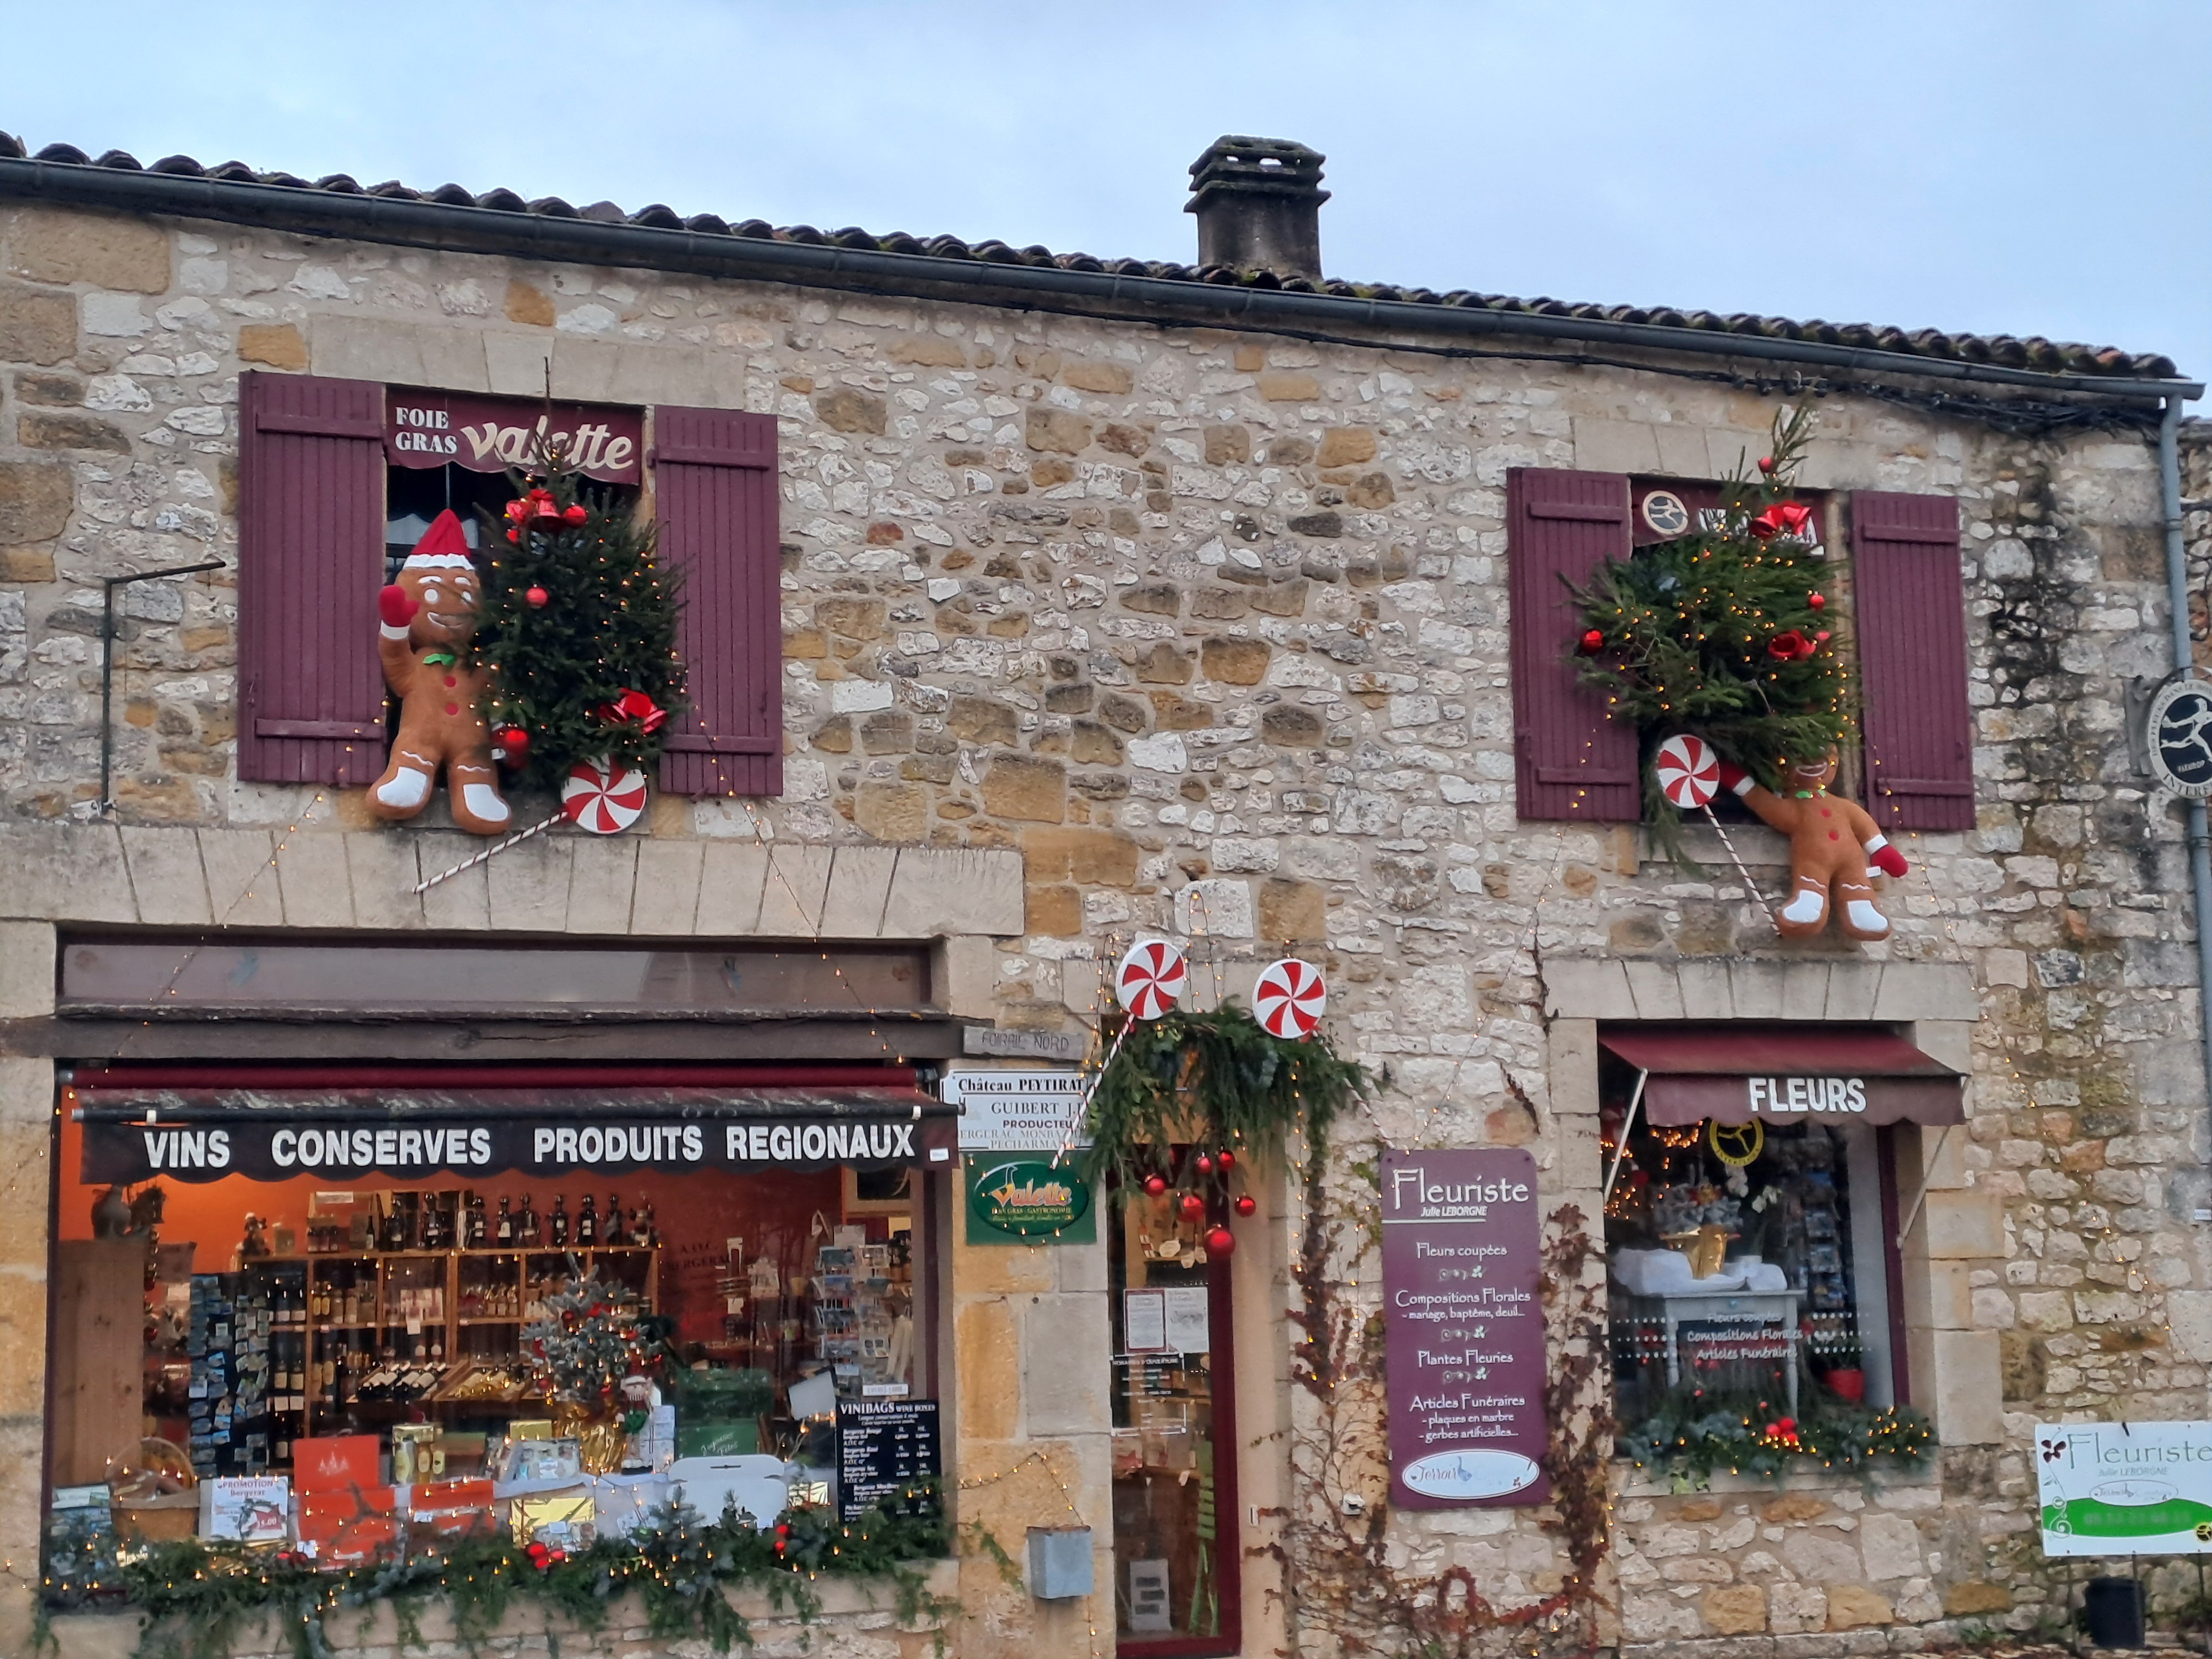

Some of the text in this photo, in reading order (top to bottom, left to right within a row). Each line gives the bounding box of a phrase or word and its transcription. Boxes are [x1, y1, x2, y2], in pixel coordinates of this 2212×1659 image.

[395, 407, 449, 429] FOIE
[394, 431, 458, 455] GRAS
[1034, 1033, 1070, 1052] NORD
[958, 1078, 1084, 1092] Château PEYTIRAT
[1749, 1077, 1866, 1113] FLEURS
[991, 1102, 1060, 1115] GUIBERT
[144, 1124, 916, 1168] VINS CONSERVES PRODUITS REGIONAUX
[989, 1177, 1073, 1208] Valette
[1393, 1166, 1530, 1210] Fleuriste
[1421, 1206, 1488, 1217] Julie LEBORGNE
[1416, 1242, 1507, 1261] Fleurs coupées
[1395, 1287, 1531, 1310] Compositions Florales
[1418, 1349, 1514, 1368] Plantes Fleuries
[839, 1402, 895, 1415] VINIBAGS
[1410, 1393, 1525, 1412] Articles Funéraires
[1482, 1410, 1514, 1422] marbre
[2067, 1432, 2212, 1469] Fleuriste
[2120, 1467, 2168, 1476] LEBORGNE
